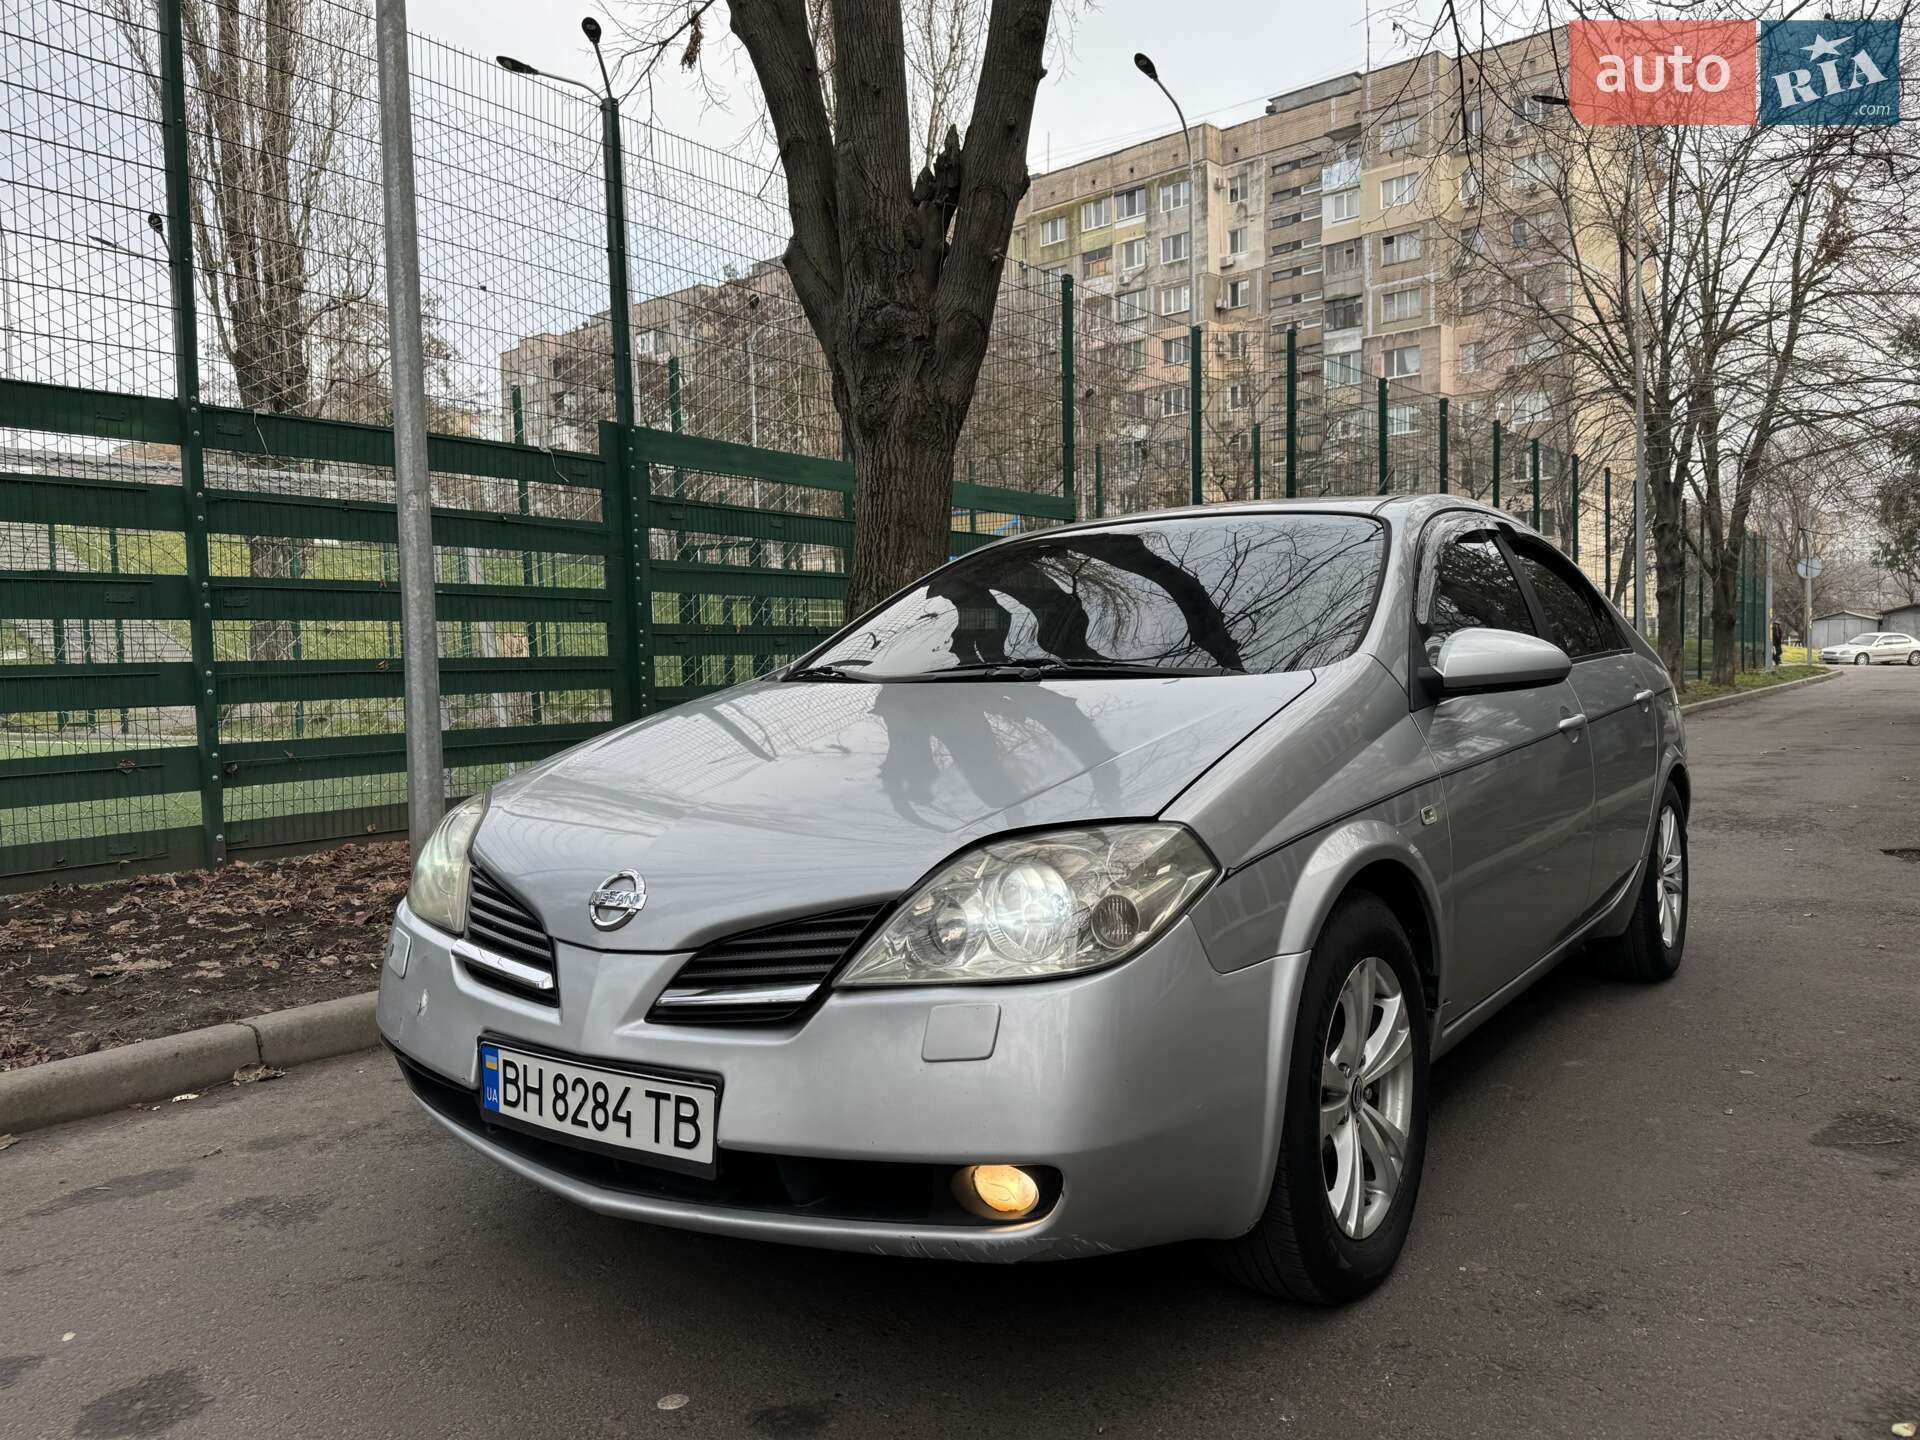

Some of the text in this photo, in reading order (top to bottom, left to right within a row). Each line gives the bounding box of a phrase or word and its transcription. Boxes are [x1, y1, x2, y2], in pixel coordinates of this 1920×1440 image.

[486, 1087, 498, 1103] UA
[502, 1059, 702, 1150] BH 8284 TB
